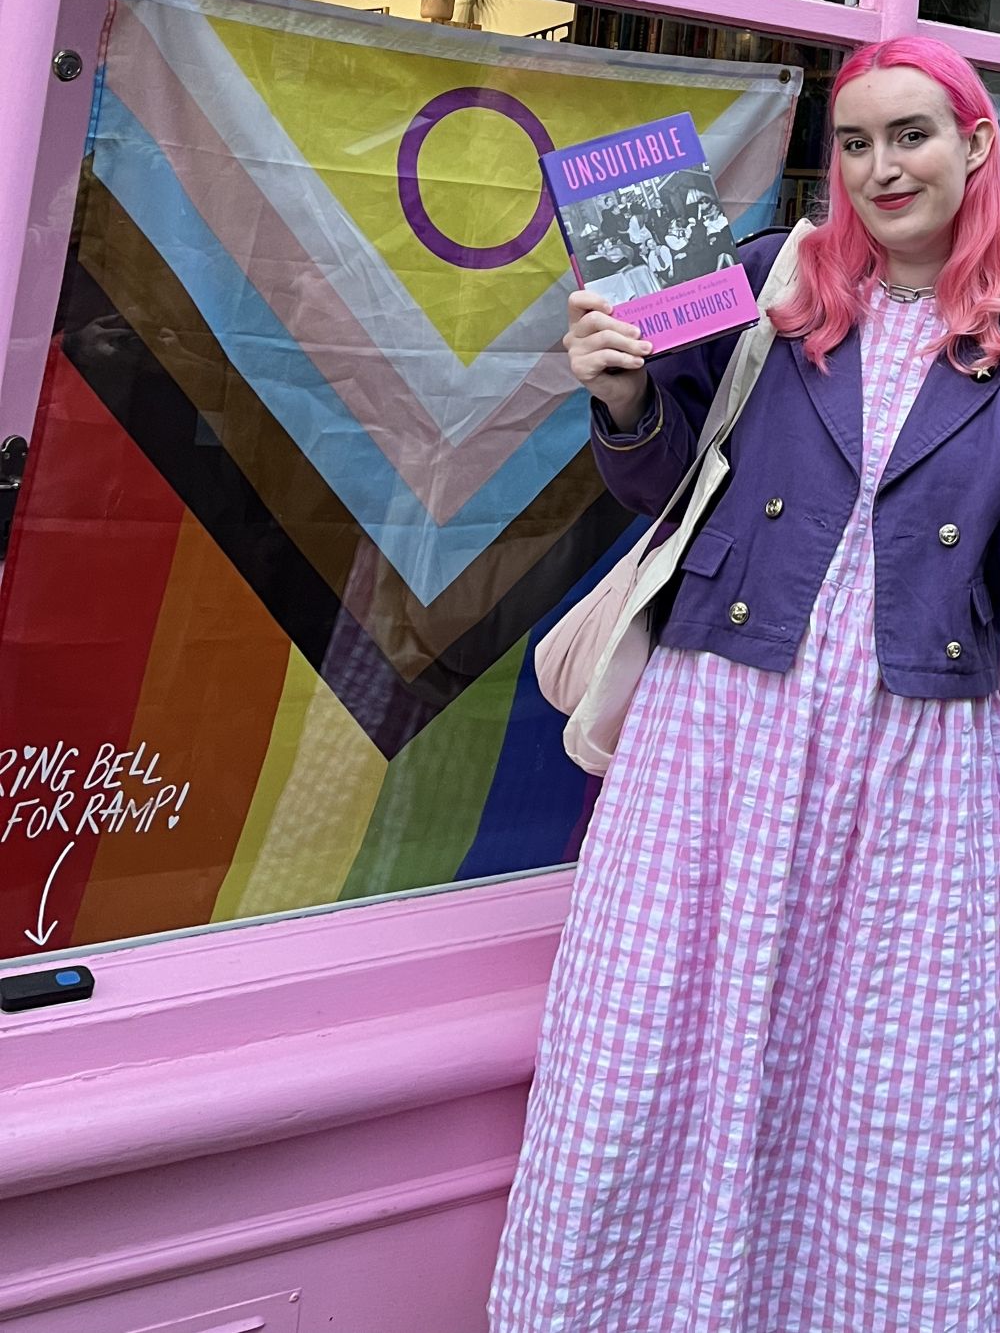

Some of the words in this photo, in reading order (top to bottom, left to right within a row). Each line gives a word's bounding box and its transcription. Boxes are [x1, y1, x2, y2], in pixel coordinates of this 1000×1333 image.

[562, 127, 686, 190] UNSUITABLE
[673, 288, 738, 326] MEDHURST
[83, 741, 162, 790] BELL
[1, 790, 75, 843] FOR
[75, 781, 190, 836] RAMP!
